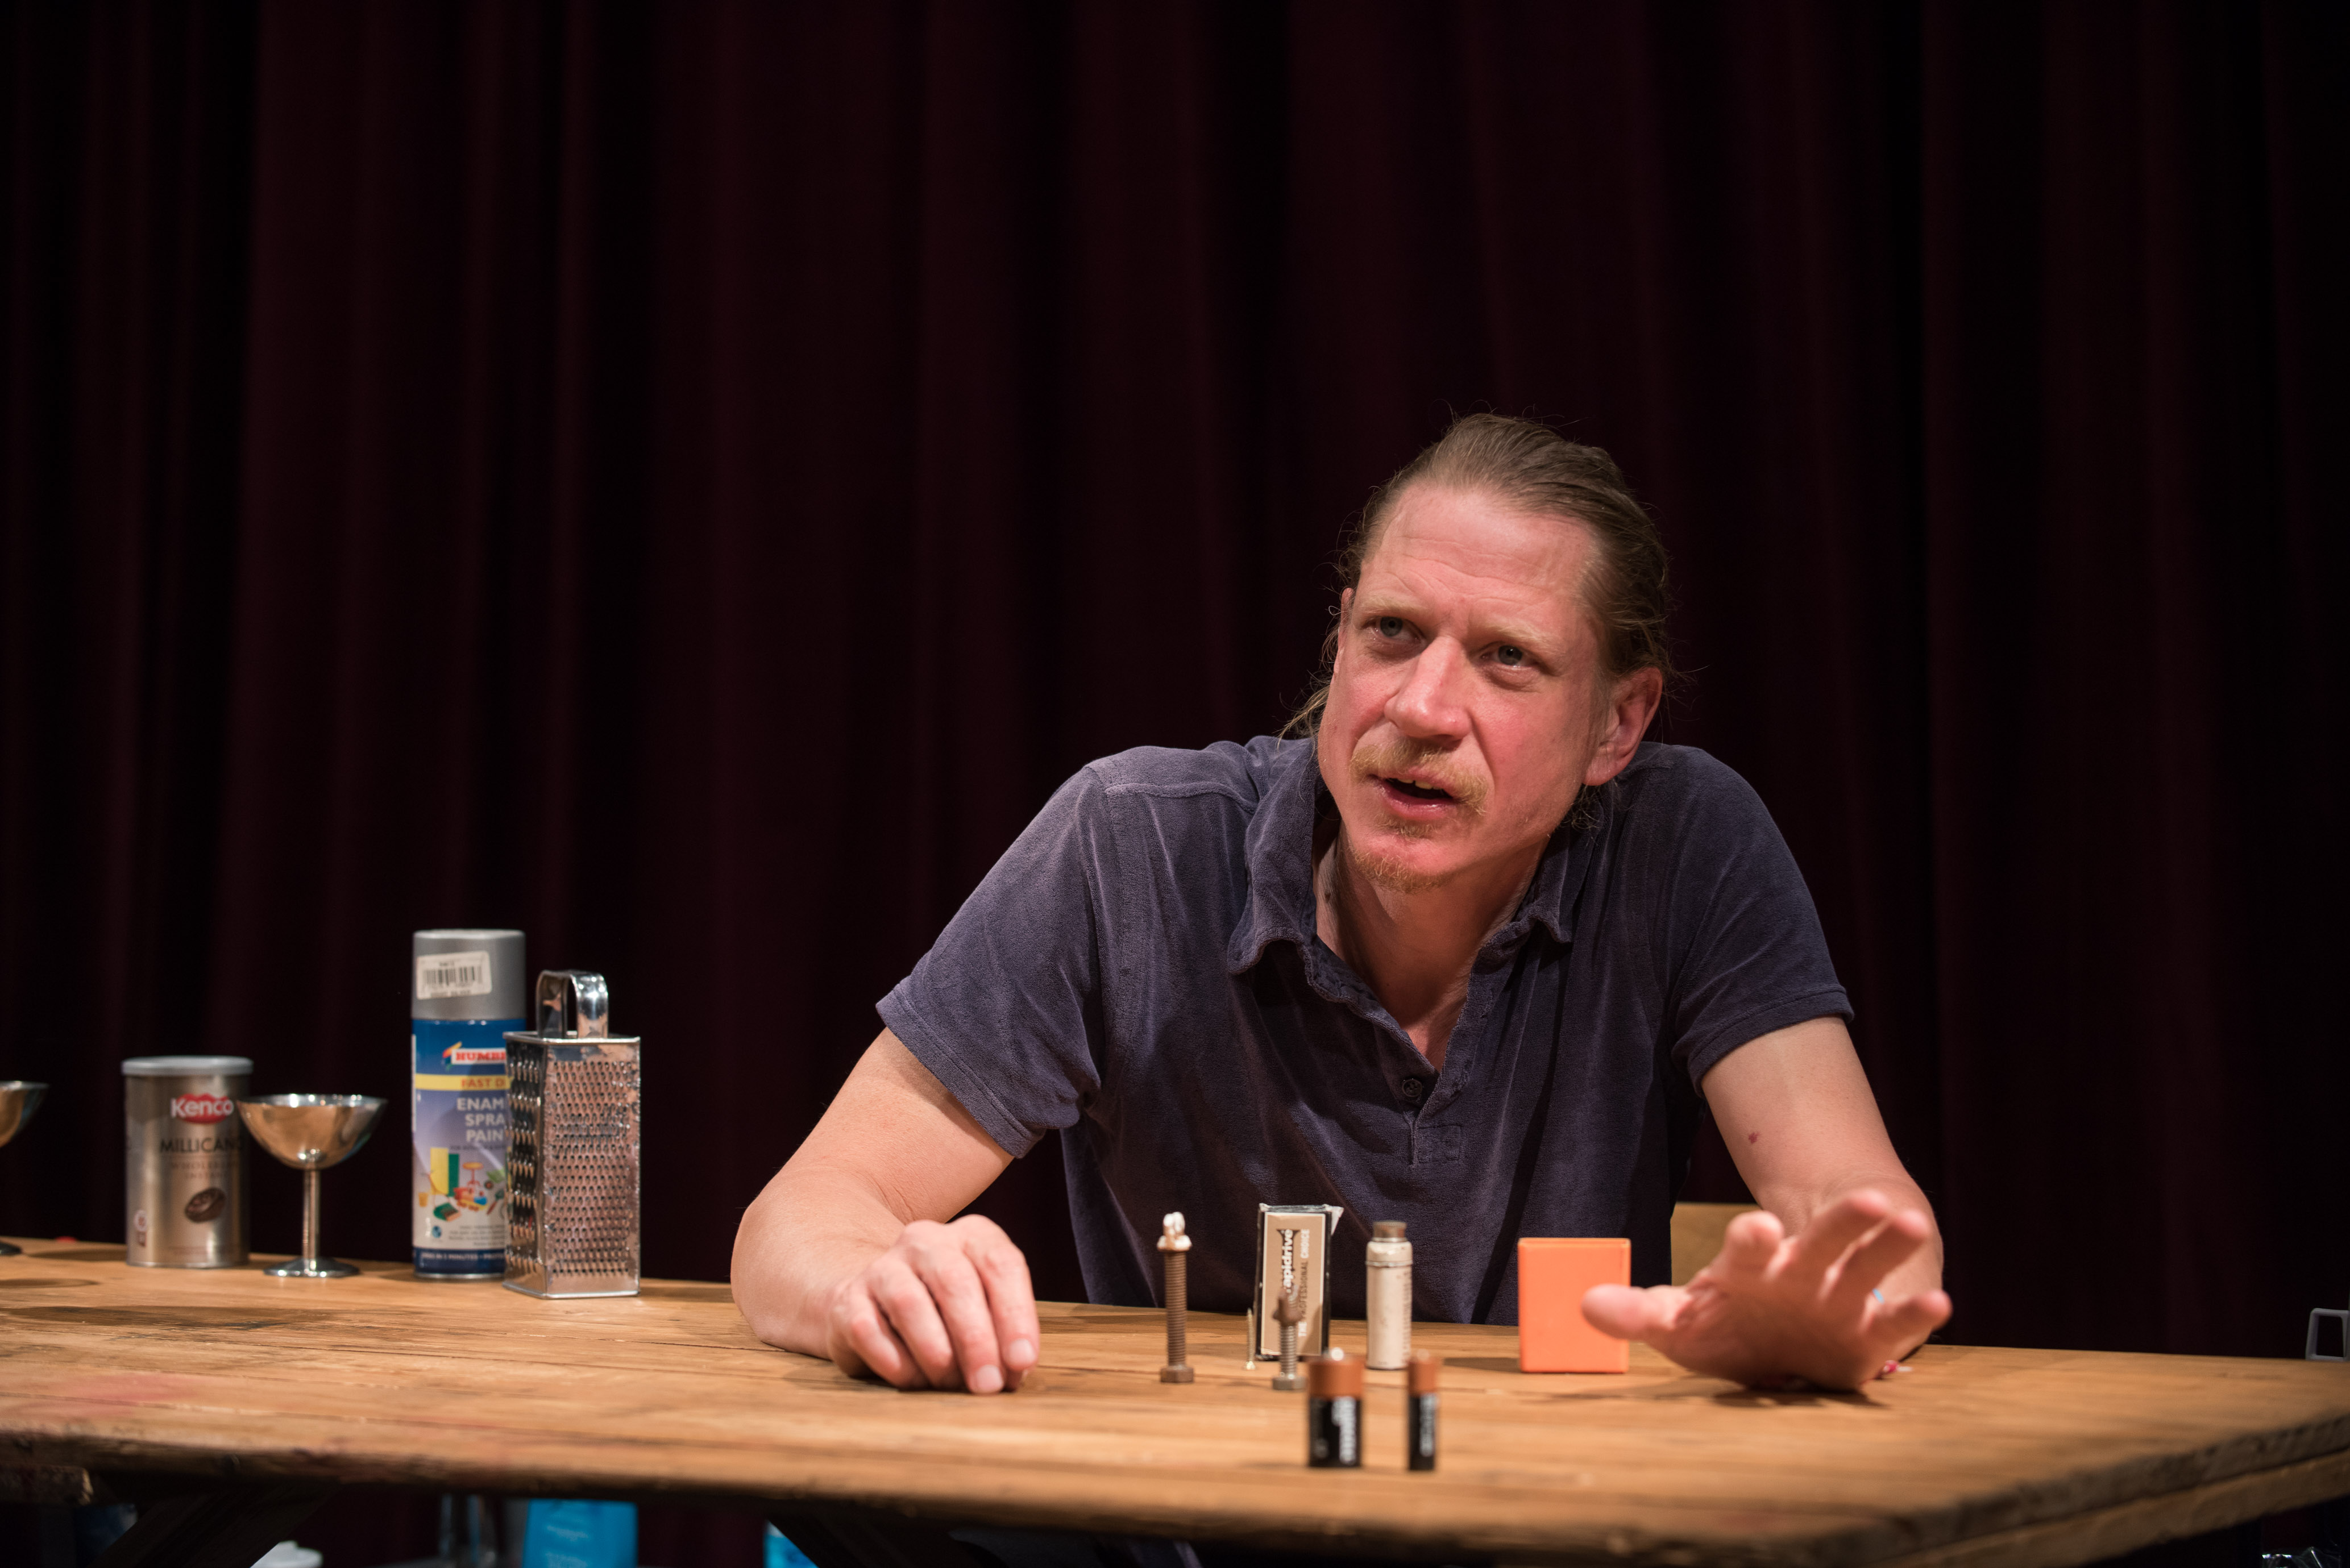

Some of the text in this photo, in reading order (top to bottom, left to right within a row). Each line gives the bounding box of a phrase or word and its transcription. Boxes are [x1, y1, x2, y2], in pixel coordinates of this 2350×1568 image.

[462, 1078, 491, 1087] FAST
[171, 1097, 234, 1118] Kenco
[456, 1097, 504, 1111] ENAM
[465, 1113, 505, 1126] SPRA
[466, 1129, 504, 1142] PAIN
[1300, 1229, 1310, 1259] CHOICE
[1282, 1229, 1293, 1293] apidrive
[1298, 1321, 1307, 1337] THE
